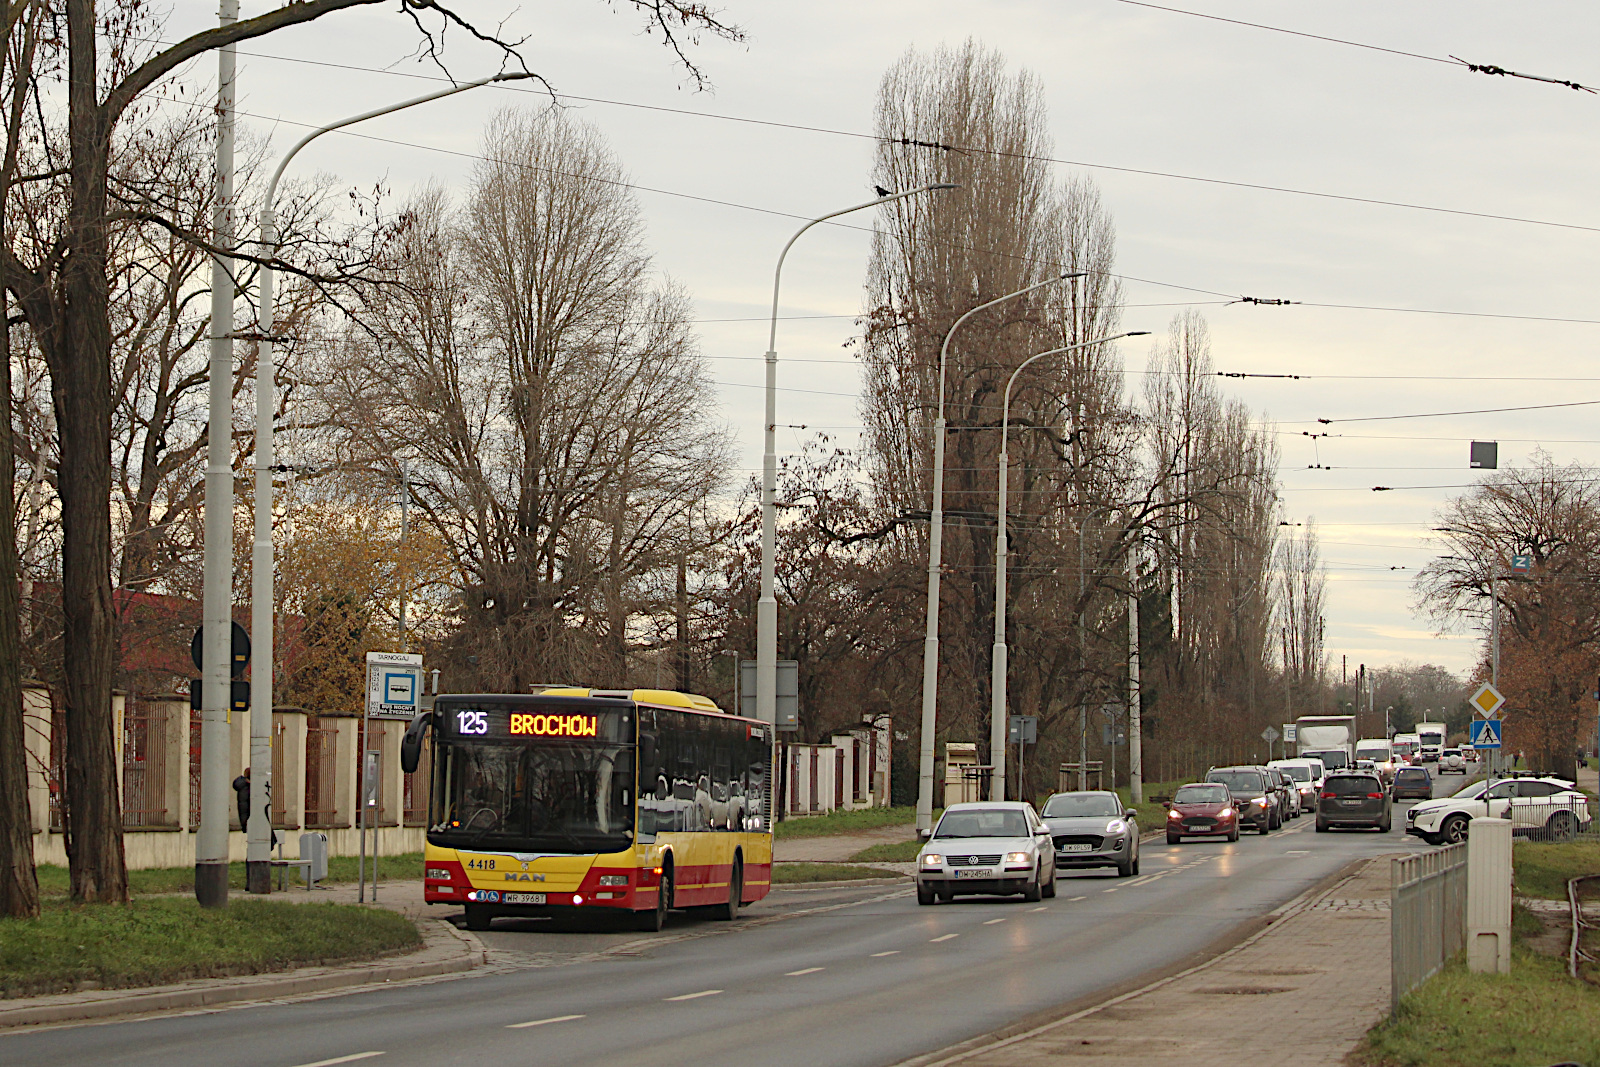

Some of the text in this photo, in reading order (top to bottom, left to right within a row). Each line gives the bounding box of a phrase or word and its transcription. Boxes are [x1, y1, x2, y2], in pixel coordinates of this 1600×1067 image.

[456, 710, 597, 736] 125 BROCHÓW
[468, 859, 496, 870] 4418
[504, 872, 546, 882] MAN
[521, 894, 545, 903] 3968T
